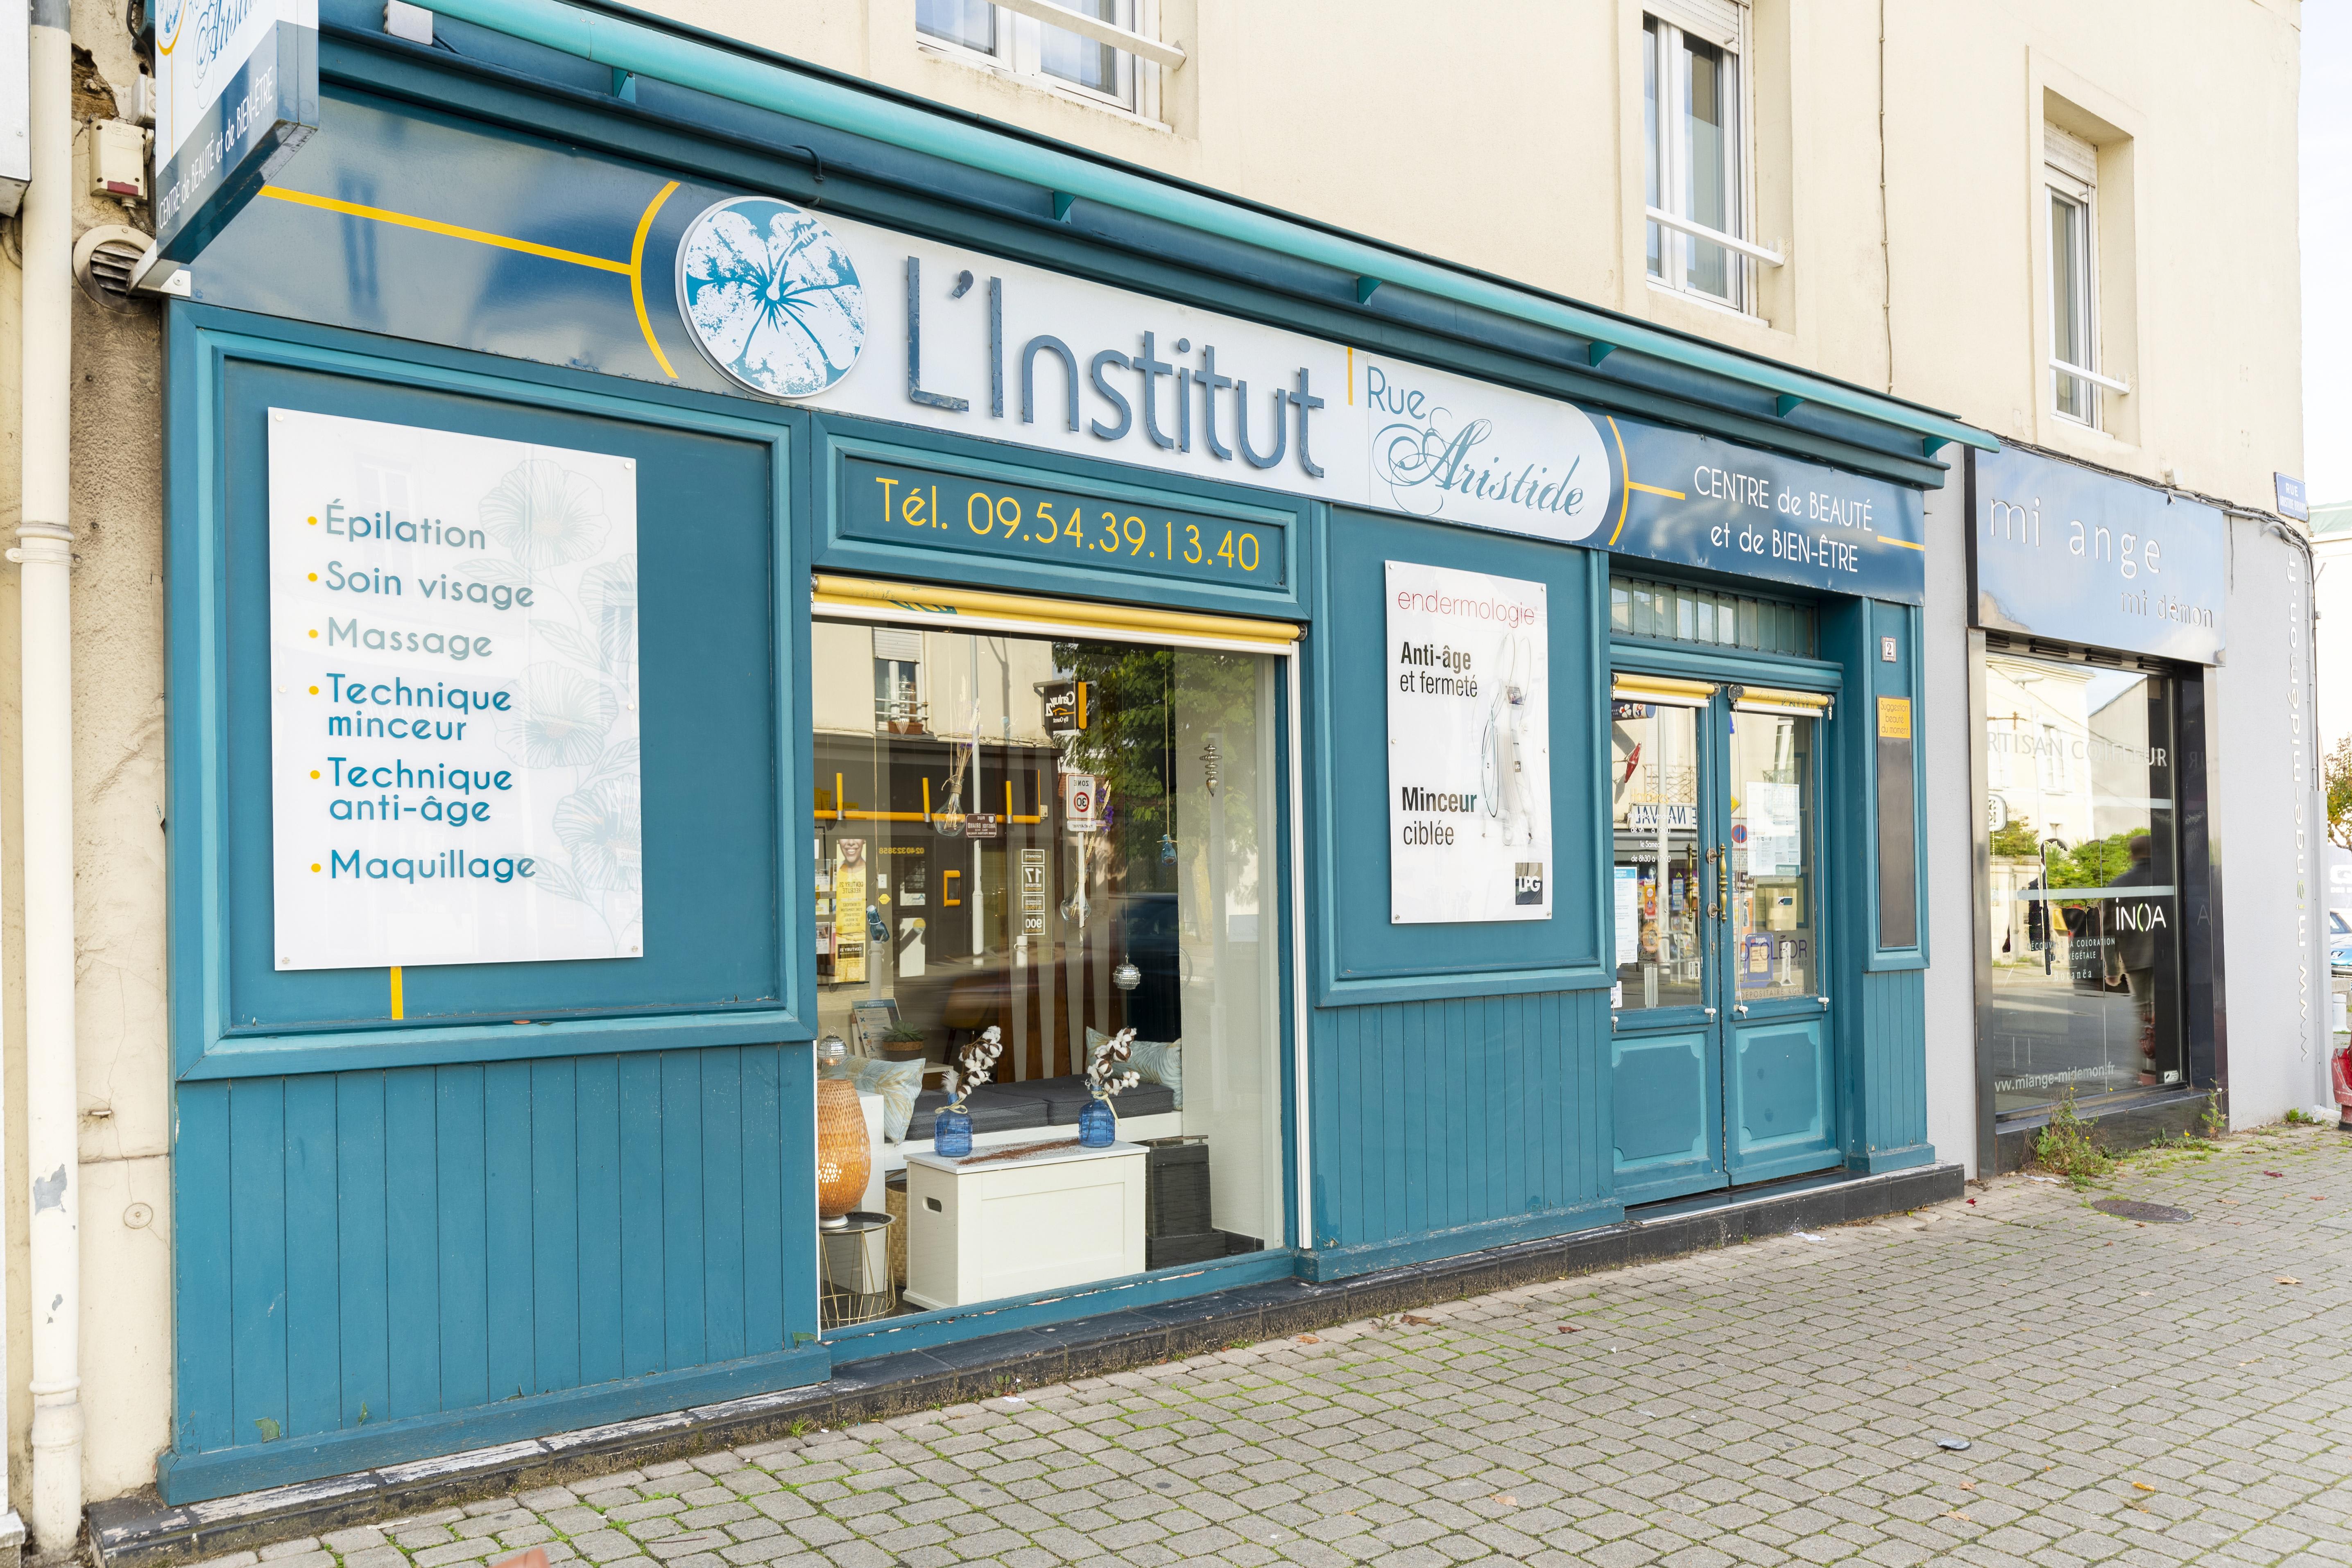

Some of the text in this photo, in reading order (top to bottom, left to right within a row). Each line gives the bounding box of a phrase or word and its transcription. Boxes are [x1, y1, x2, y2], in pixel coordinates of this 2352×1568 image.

[159, 66, 273, 229] CENTRE de BEAUTÉ et de BIEN-ÊTRE
[907, 255, 1325, 479] L'Institut
[1368, 366, 1426, 420] Rue
[1372, 407, 1584, 516] Aristide
[1694, 466, 1872, 532] CENTRE de BEAUTÉ
[2286, 482, 2298, 497] RUE
[326, 498, 485, 550] Épilation
[876, 477, 1259, 571] Tél. 09.54.39.13.40
[1990, 497, 2161, 579] mi ange
[1711, 522, 1858, 573] et de BIEN-ÊTRE
[326, 561, 534, 611] Soin visage
[2122, 589, 2213, 629] mi démon
[328, 617, 493, 661] Massage
[1887, 643, 1892, 655] 2
[1401, 641, 1471, 674] Anti-âge
[326, 673, 512, 715] Technique
[1400, 670, 1478, 697] et fermeté
[1881, 700, 1908, 712] Suggestion
[1886, 714, 1904, 724] beauté
[329, 710, 466, 740] minceur
[1988, 731, 2063, 758] RTISAN
[327, 757, 513, 795] Technique
[329, 794, 491, 827] anti-âge
[1402, 786, 1477, 813] Minceur
[1403, 820, 1454, 845] ciblée
[331, 849, 536, 884] Maquillage
[1519, 876, 1541, 892] LPG
[2068, 950, 2096, 961] VÉGÉTALE
[2077, 937, 2115, 948] COLORATION
